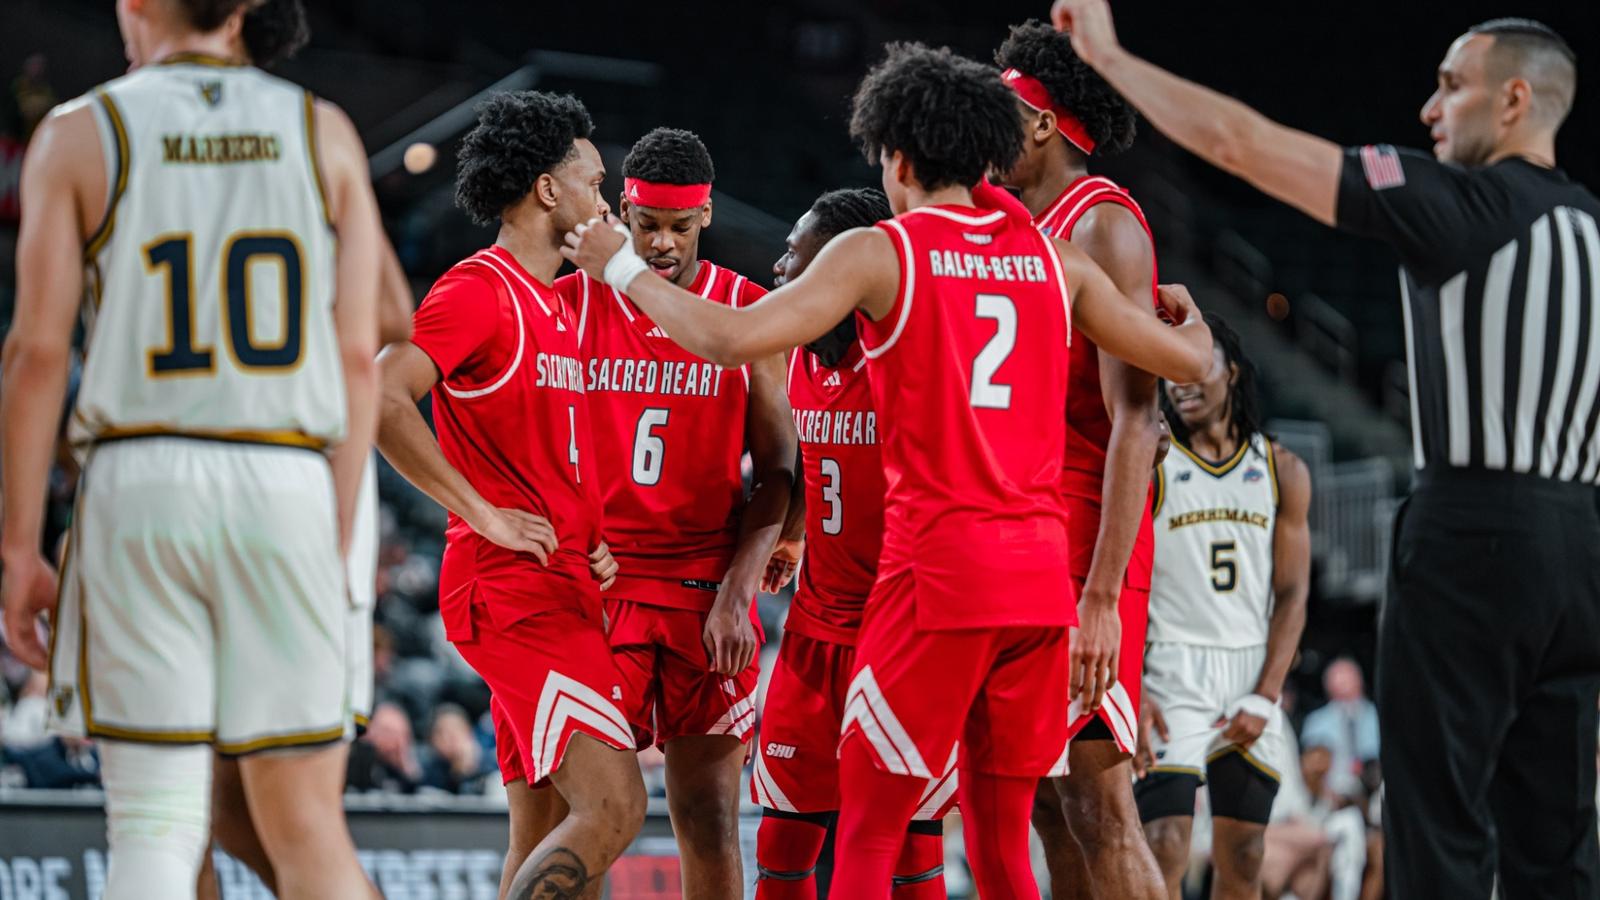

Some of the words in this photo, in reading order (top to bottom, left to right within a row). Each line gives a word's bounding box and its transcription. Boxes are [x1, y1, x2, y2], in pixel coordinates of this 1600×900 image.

[929, 249, 1048, 283] RALPH-BEYER
[141, 229, 307, 379] 10
[970, 293, 1018, 410] 2
[586, 357, 658, 394] SACRED
[659, 360, 724, 398] HEART
[631, 406, 672, 487] 6
[832, 409, 884, 445] HEAR
[819, 456, 844, 537] 3
[1167, 507, 1269, 531] MERRIMACK
[1209, 539, 1238, 594] 5
[765, 742, 797, 760] SHU
